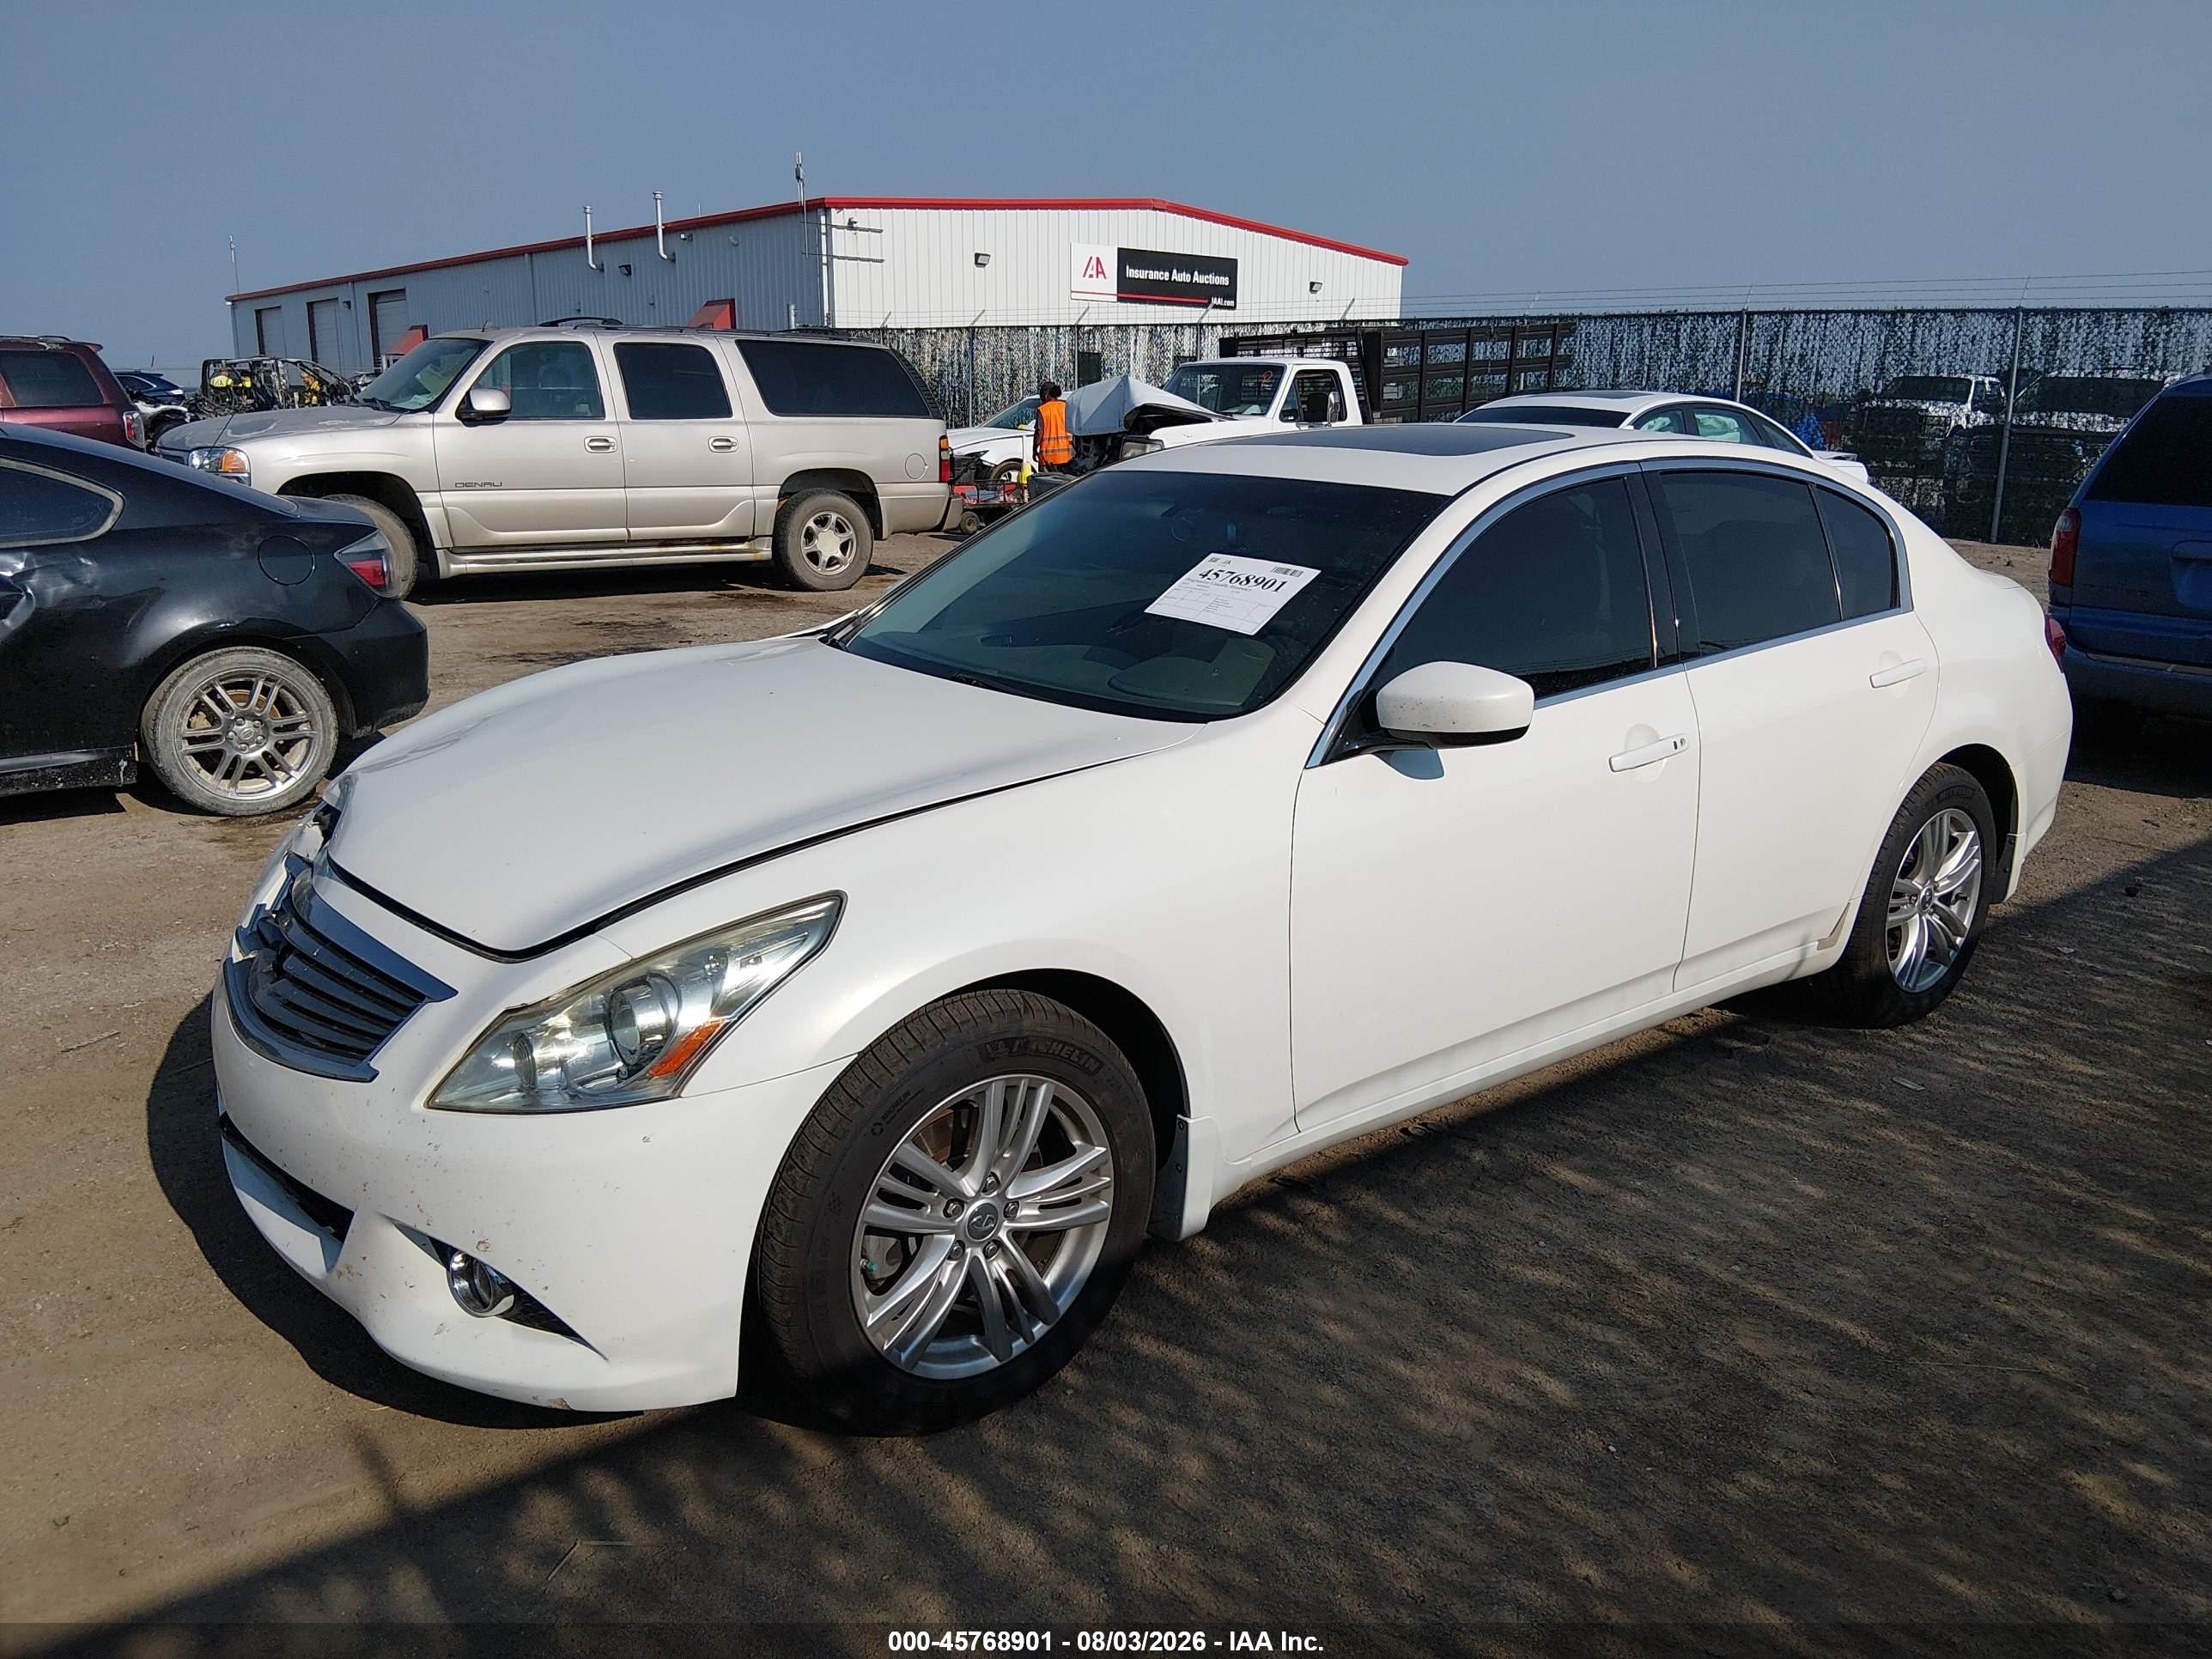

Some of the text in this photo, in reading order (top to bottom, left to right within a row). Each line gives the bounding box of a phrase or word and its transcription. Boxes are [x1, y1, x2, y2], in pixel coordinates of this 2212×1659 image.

[1126, 264, 1230, 287] Insurance Auto Auctions
[1199, 568, 1288, 592] 45768901
